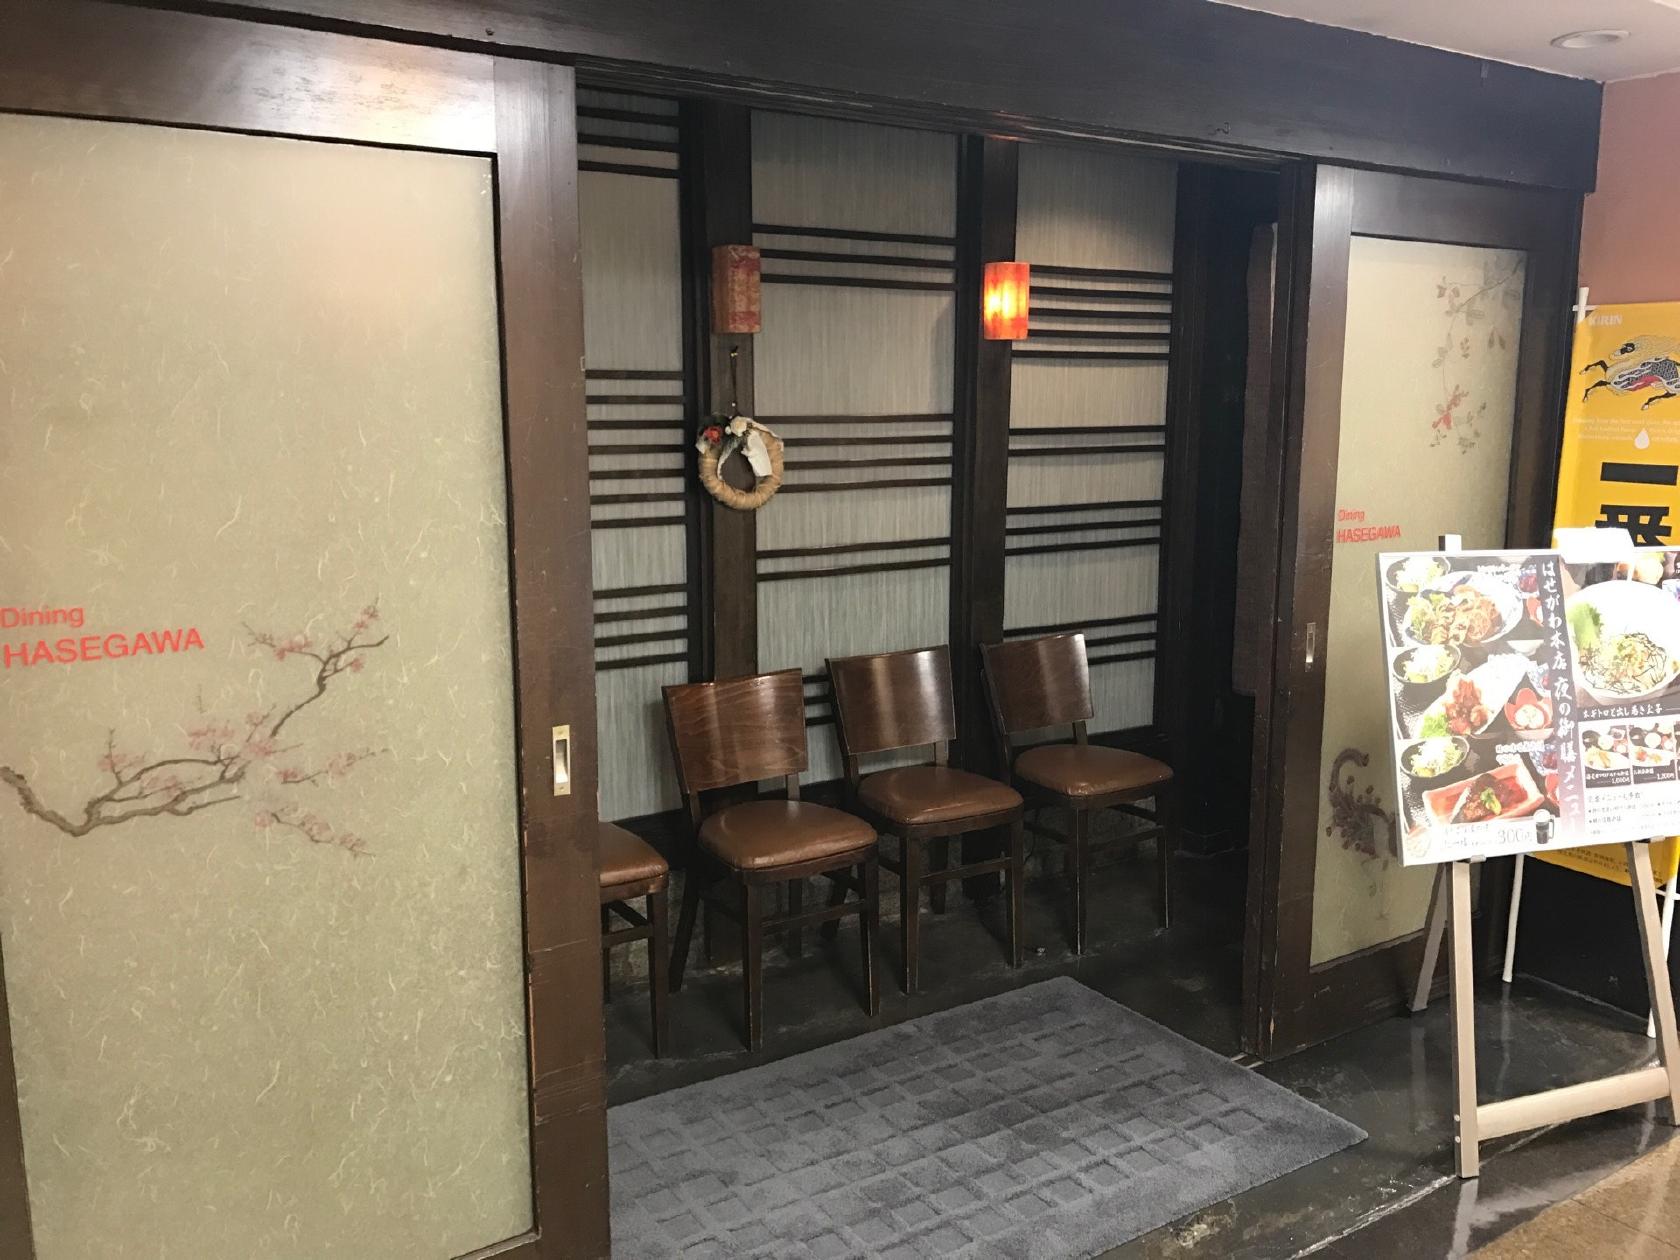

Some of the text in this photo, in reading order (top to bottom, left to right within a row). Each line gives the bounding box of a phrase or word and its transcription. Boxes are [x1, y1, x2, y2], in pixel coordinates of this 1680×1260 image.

[1588, 314, 1623, 327] KIRIN
[1336, 525, 1402, 543] HASEGAWA
[0, 606, 84, 629] Dining
[4, 627, 205, 668] HASEGAWA
